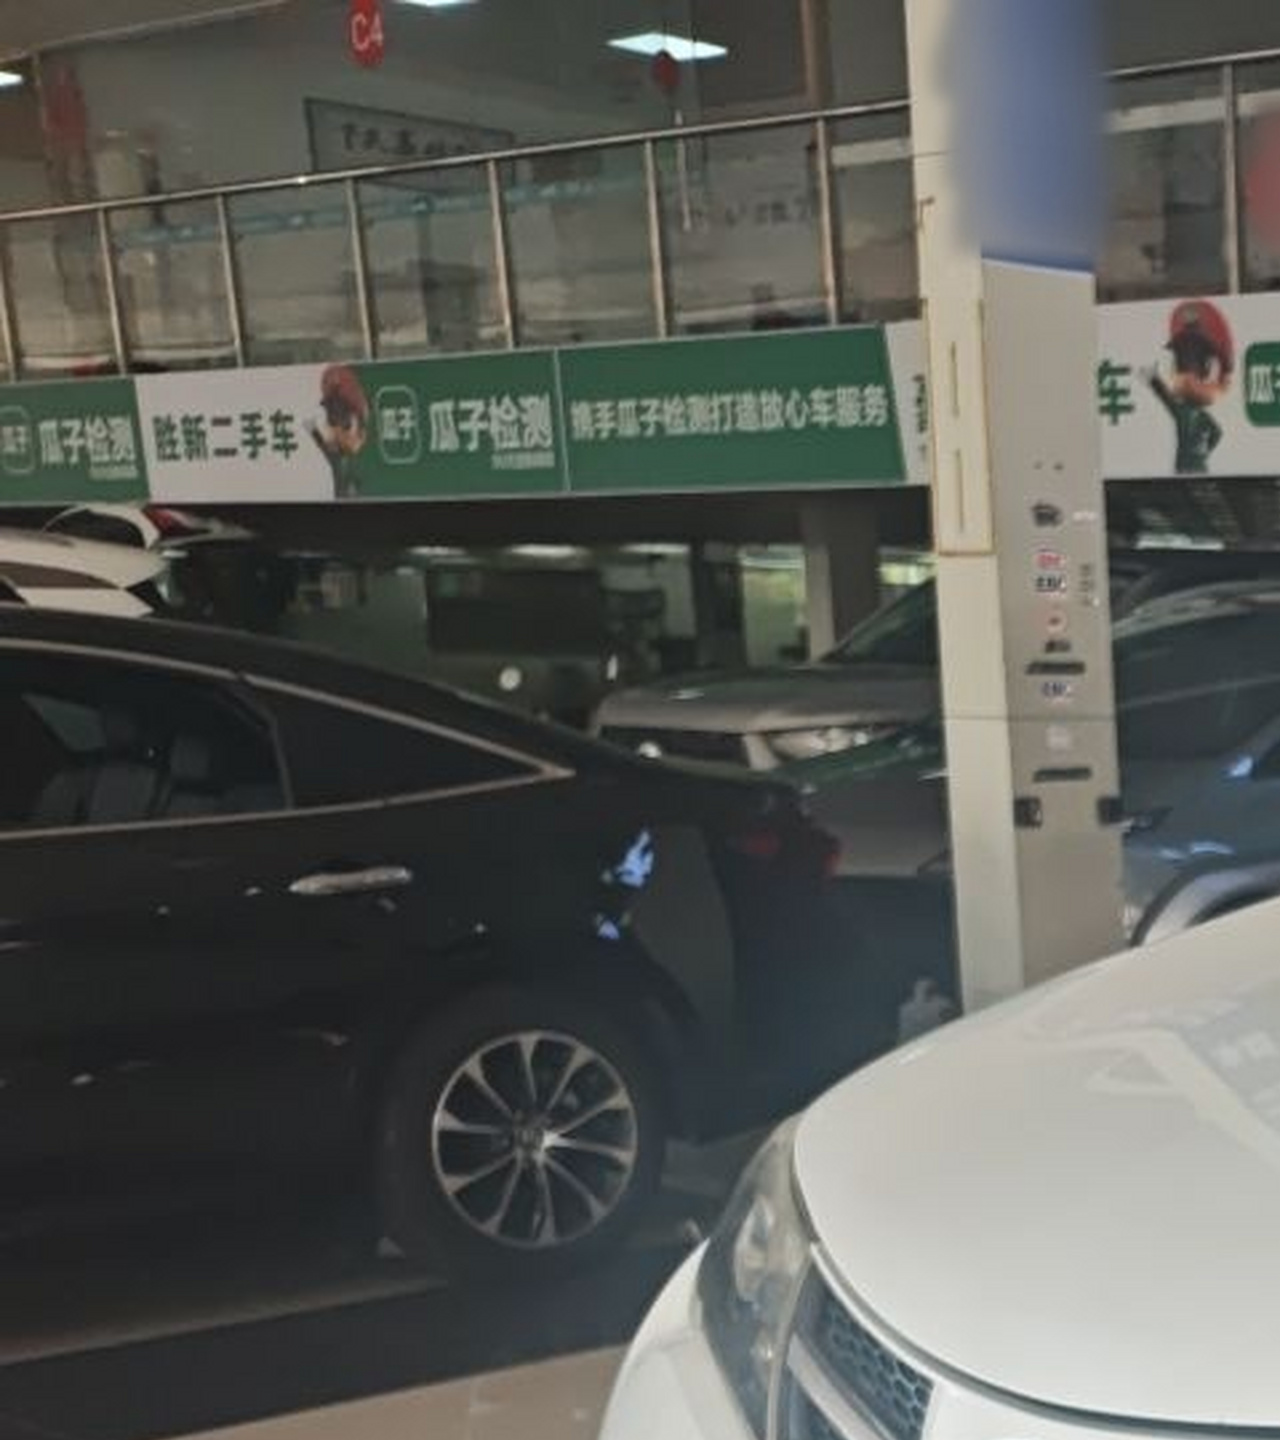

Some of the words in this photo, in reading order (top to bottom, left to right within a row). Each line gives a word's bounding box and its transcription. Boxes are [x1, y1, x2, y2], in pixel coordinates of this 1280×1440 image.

[38, 414, 137, 465] 瓜子检测
[429, 392, 552, 453] 瓜子检测
